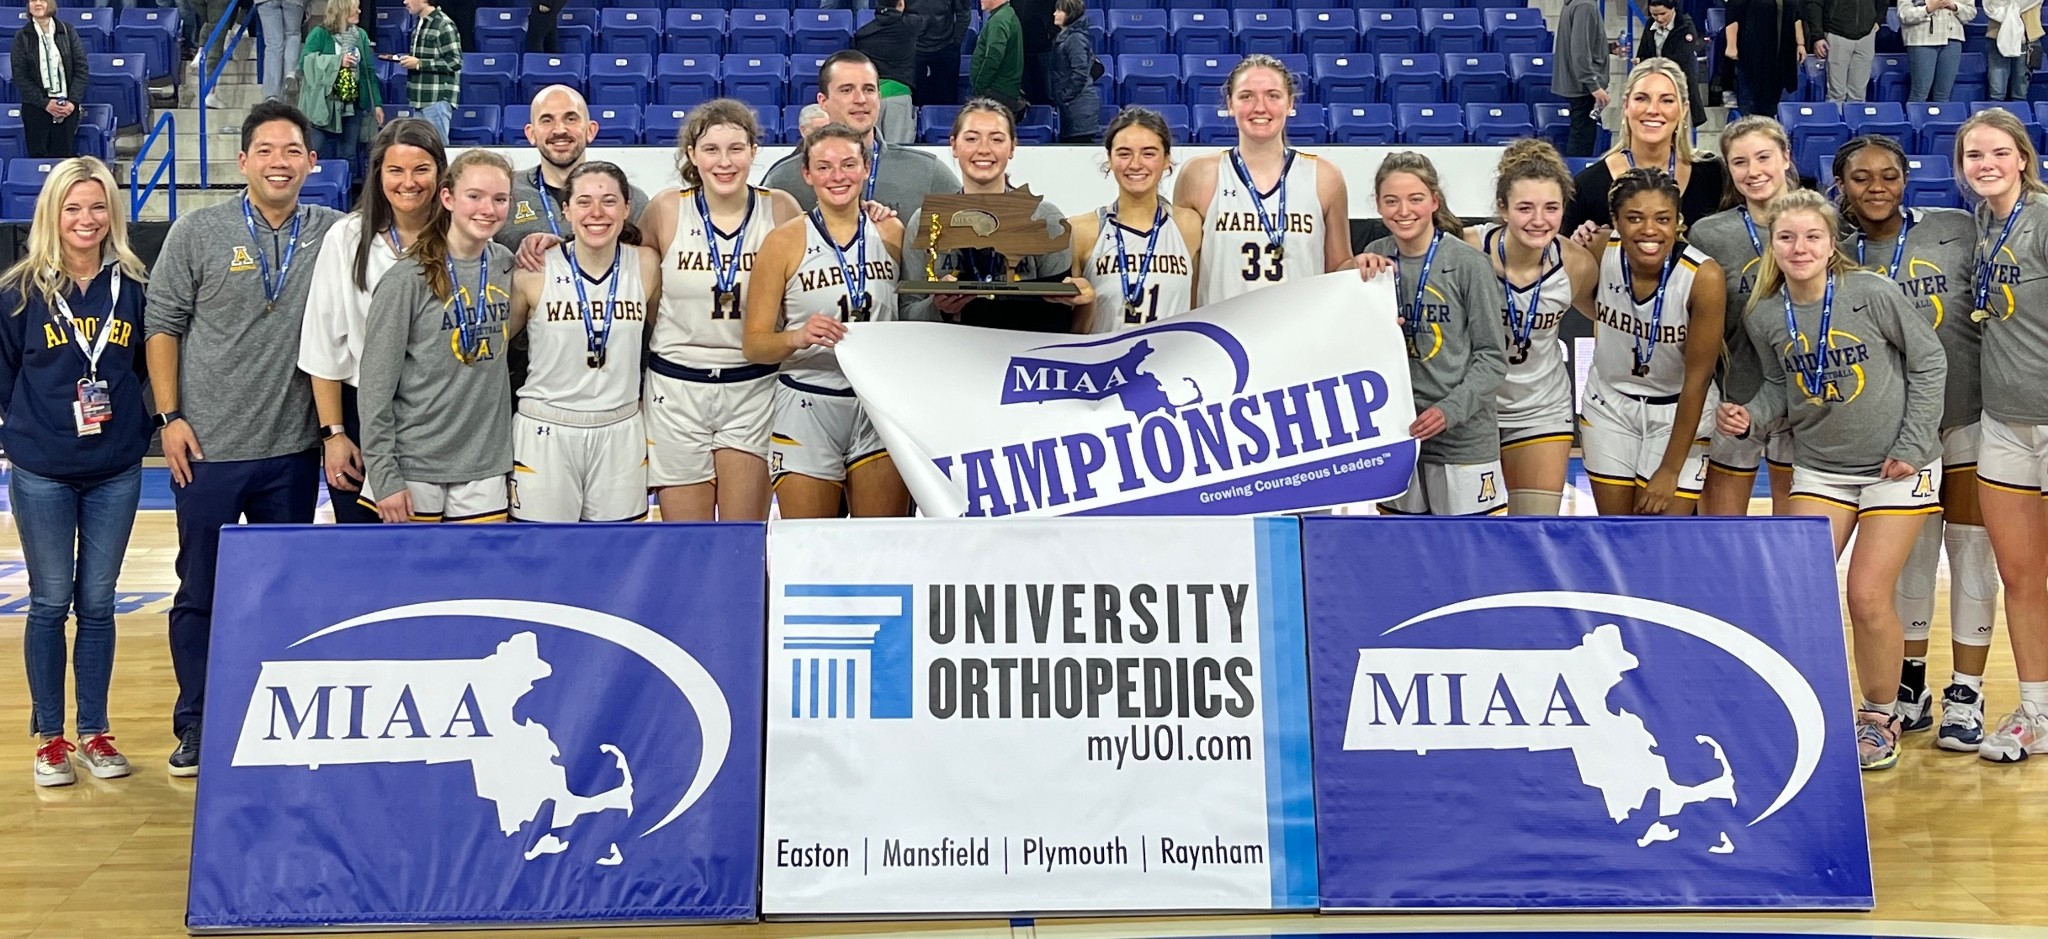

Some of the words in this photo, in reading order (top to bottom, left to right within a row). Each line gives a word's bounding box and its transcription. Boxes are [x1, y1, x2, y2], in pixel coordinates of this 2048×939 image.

[798, 261, 894, 292] WARRORS
[1241, 242, 1283, 281] 33
[546, 301, 643, 321] WARRORS
[711, 282, 742, 319] 11
[837, 292, 872, 322] 13
[1124, 283, 1160, 323] 21
[44, 317, 132, 349] ADOER
[1013, 365, 1129, 394] MIAA
[931, 370, 1389, 517] AMPIONSHIP
[1200, 484, 1253, 504] Growing
[1255, 467, 1331, 493] Courageous
[1478, 471, 1497, 503] A
[1912, 469, 1935, 497] A
[929, 584, 1249, 644] UNIVERSITY
[929, 656, 1255, 719] ORTHOPEDICS
[1366, 672, 1590, 726] MIAA
[263, 683, 494, 740] MIAA
[1088, 724, 1252, 769] myUOI.com
[777, 838, 849, 868] Easton
[883, 836, 990, 868] Mansfield
[1023, 836, 1129, 873] Plymouth
[1160, 836, 1264, 872] Raynham
